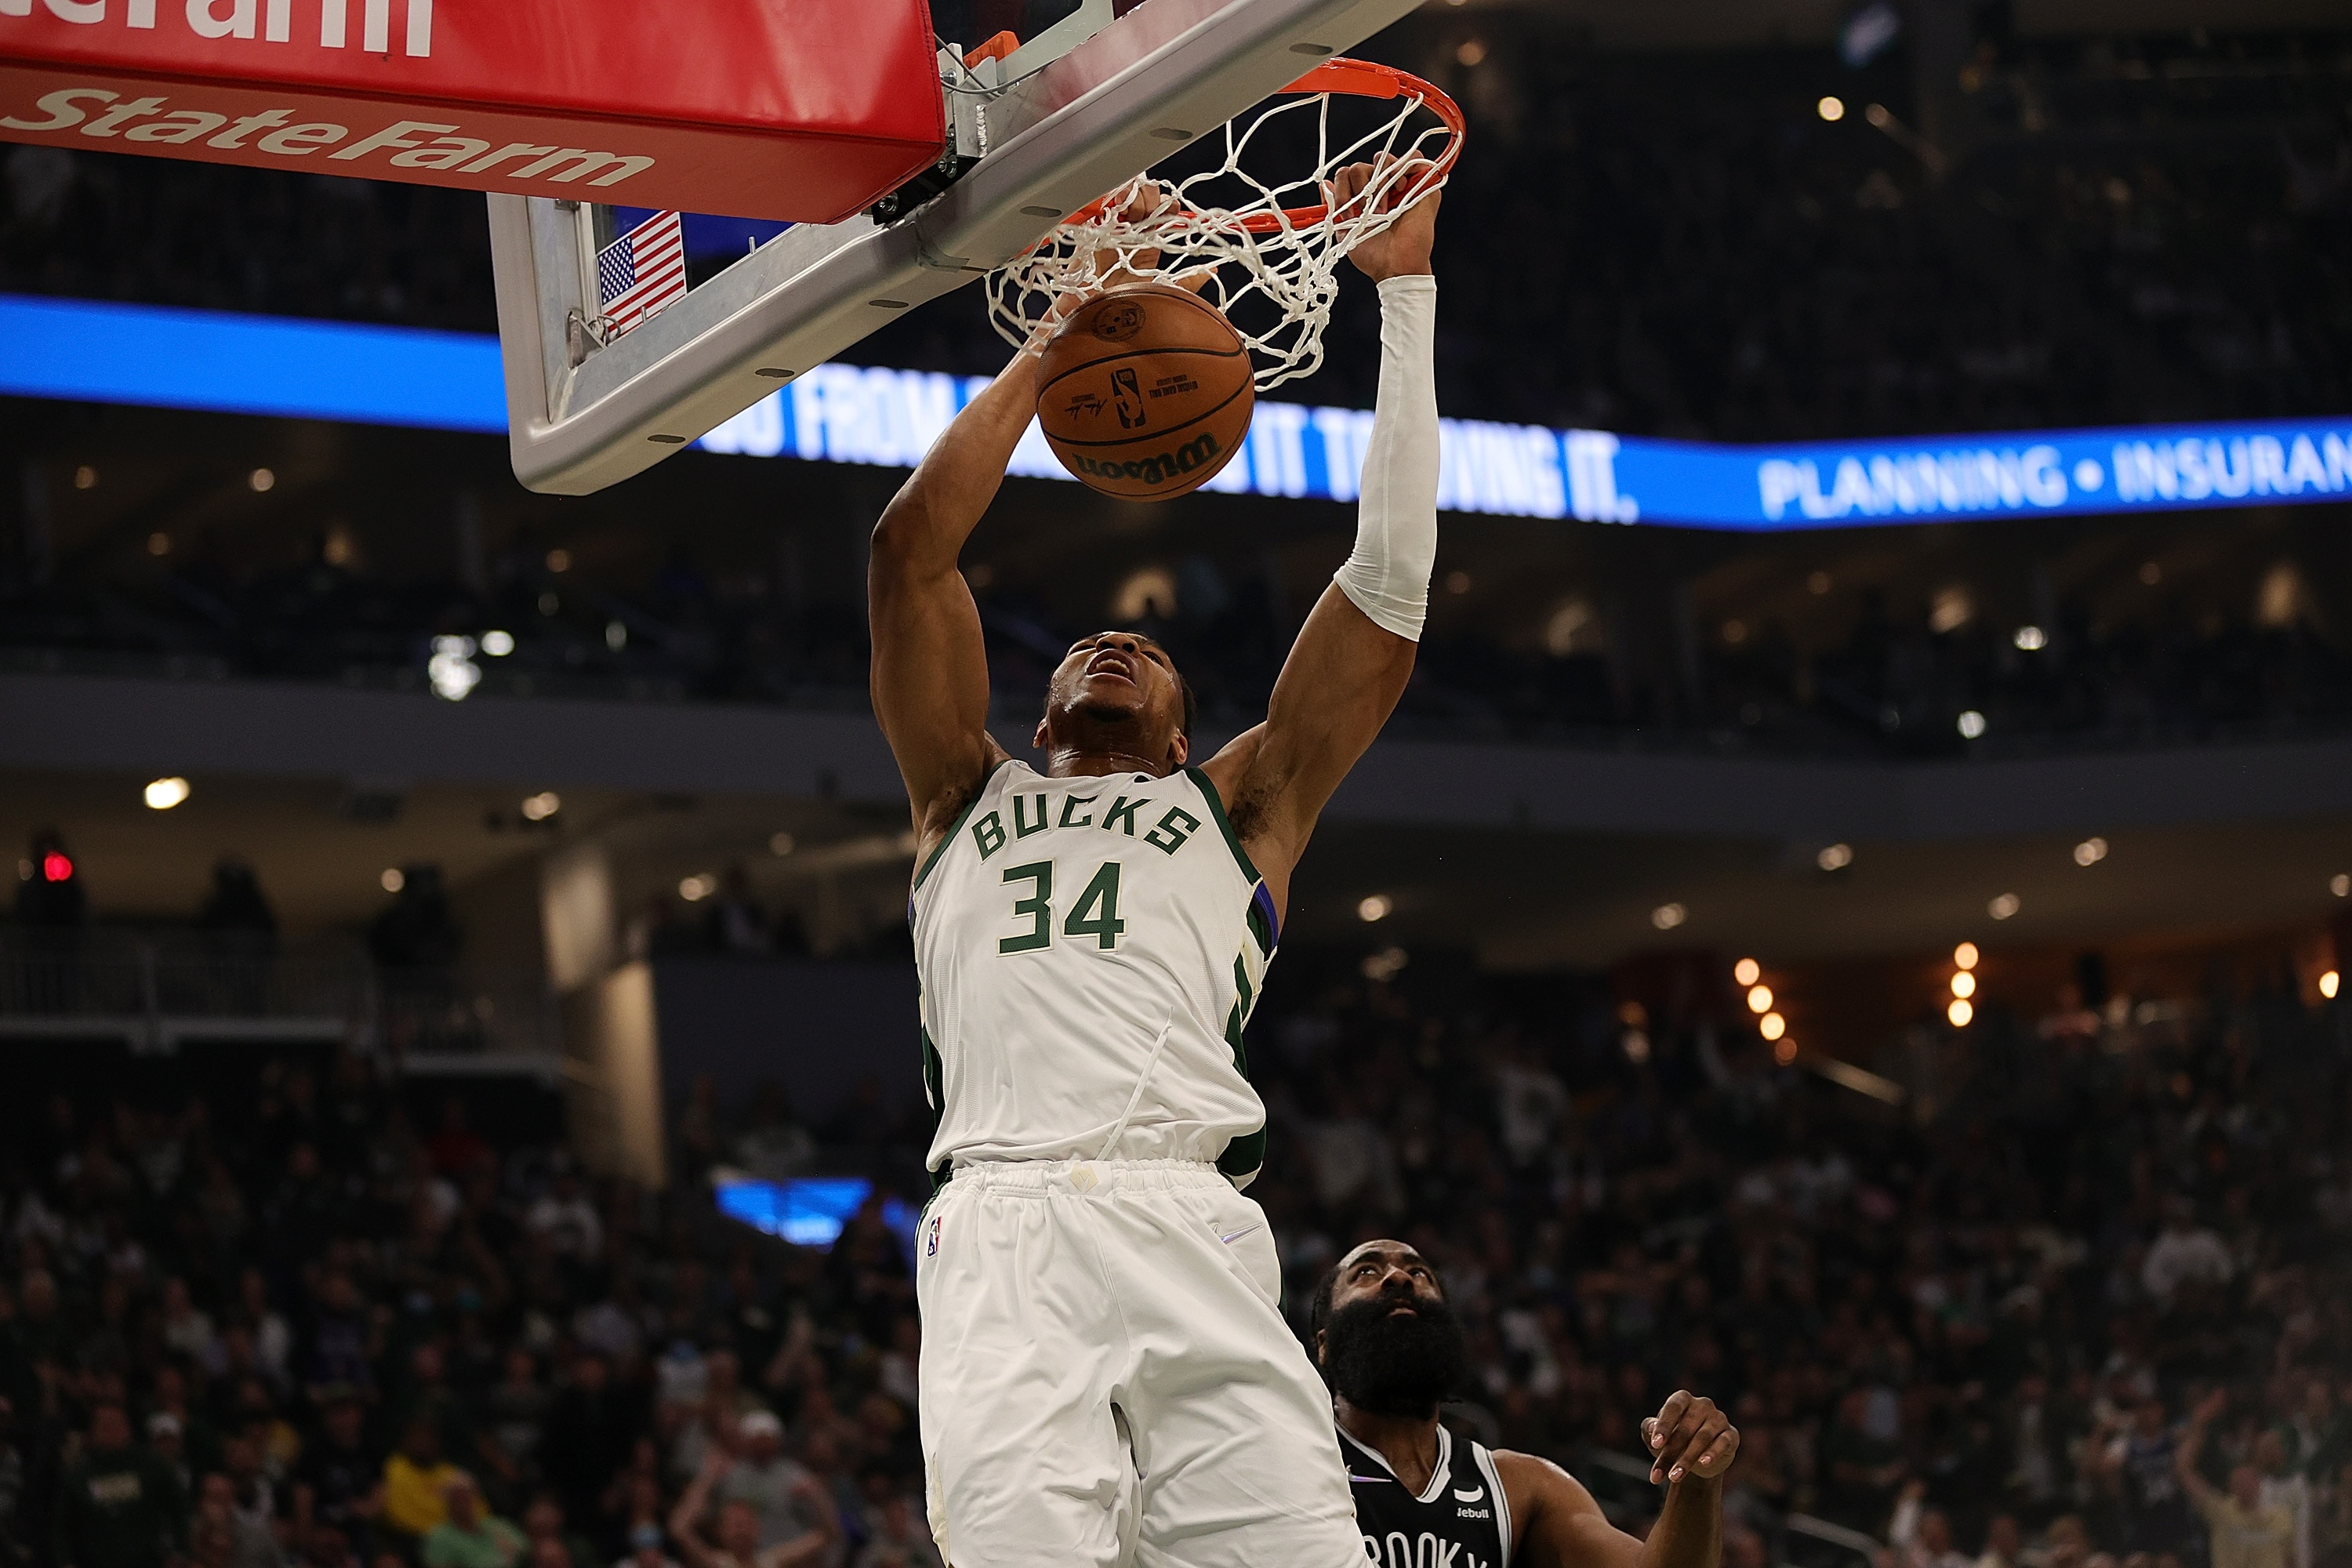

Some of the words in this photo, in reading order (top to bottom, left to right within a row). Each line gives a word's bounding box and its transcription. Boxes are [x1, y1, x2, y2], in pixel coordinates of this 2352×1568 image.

[1072, 432, 1222, 485] Wilson
[1759, 445, 2068, 521] PLANNING
[970, 793, 1203, 864] BUCKS
[997, 858, 1127, 956] 34
